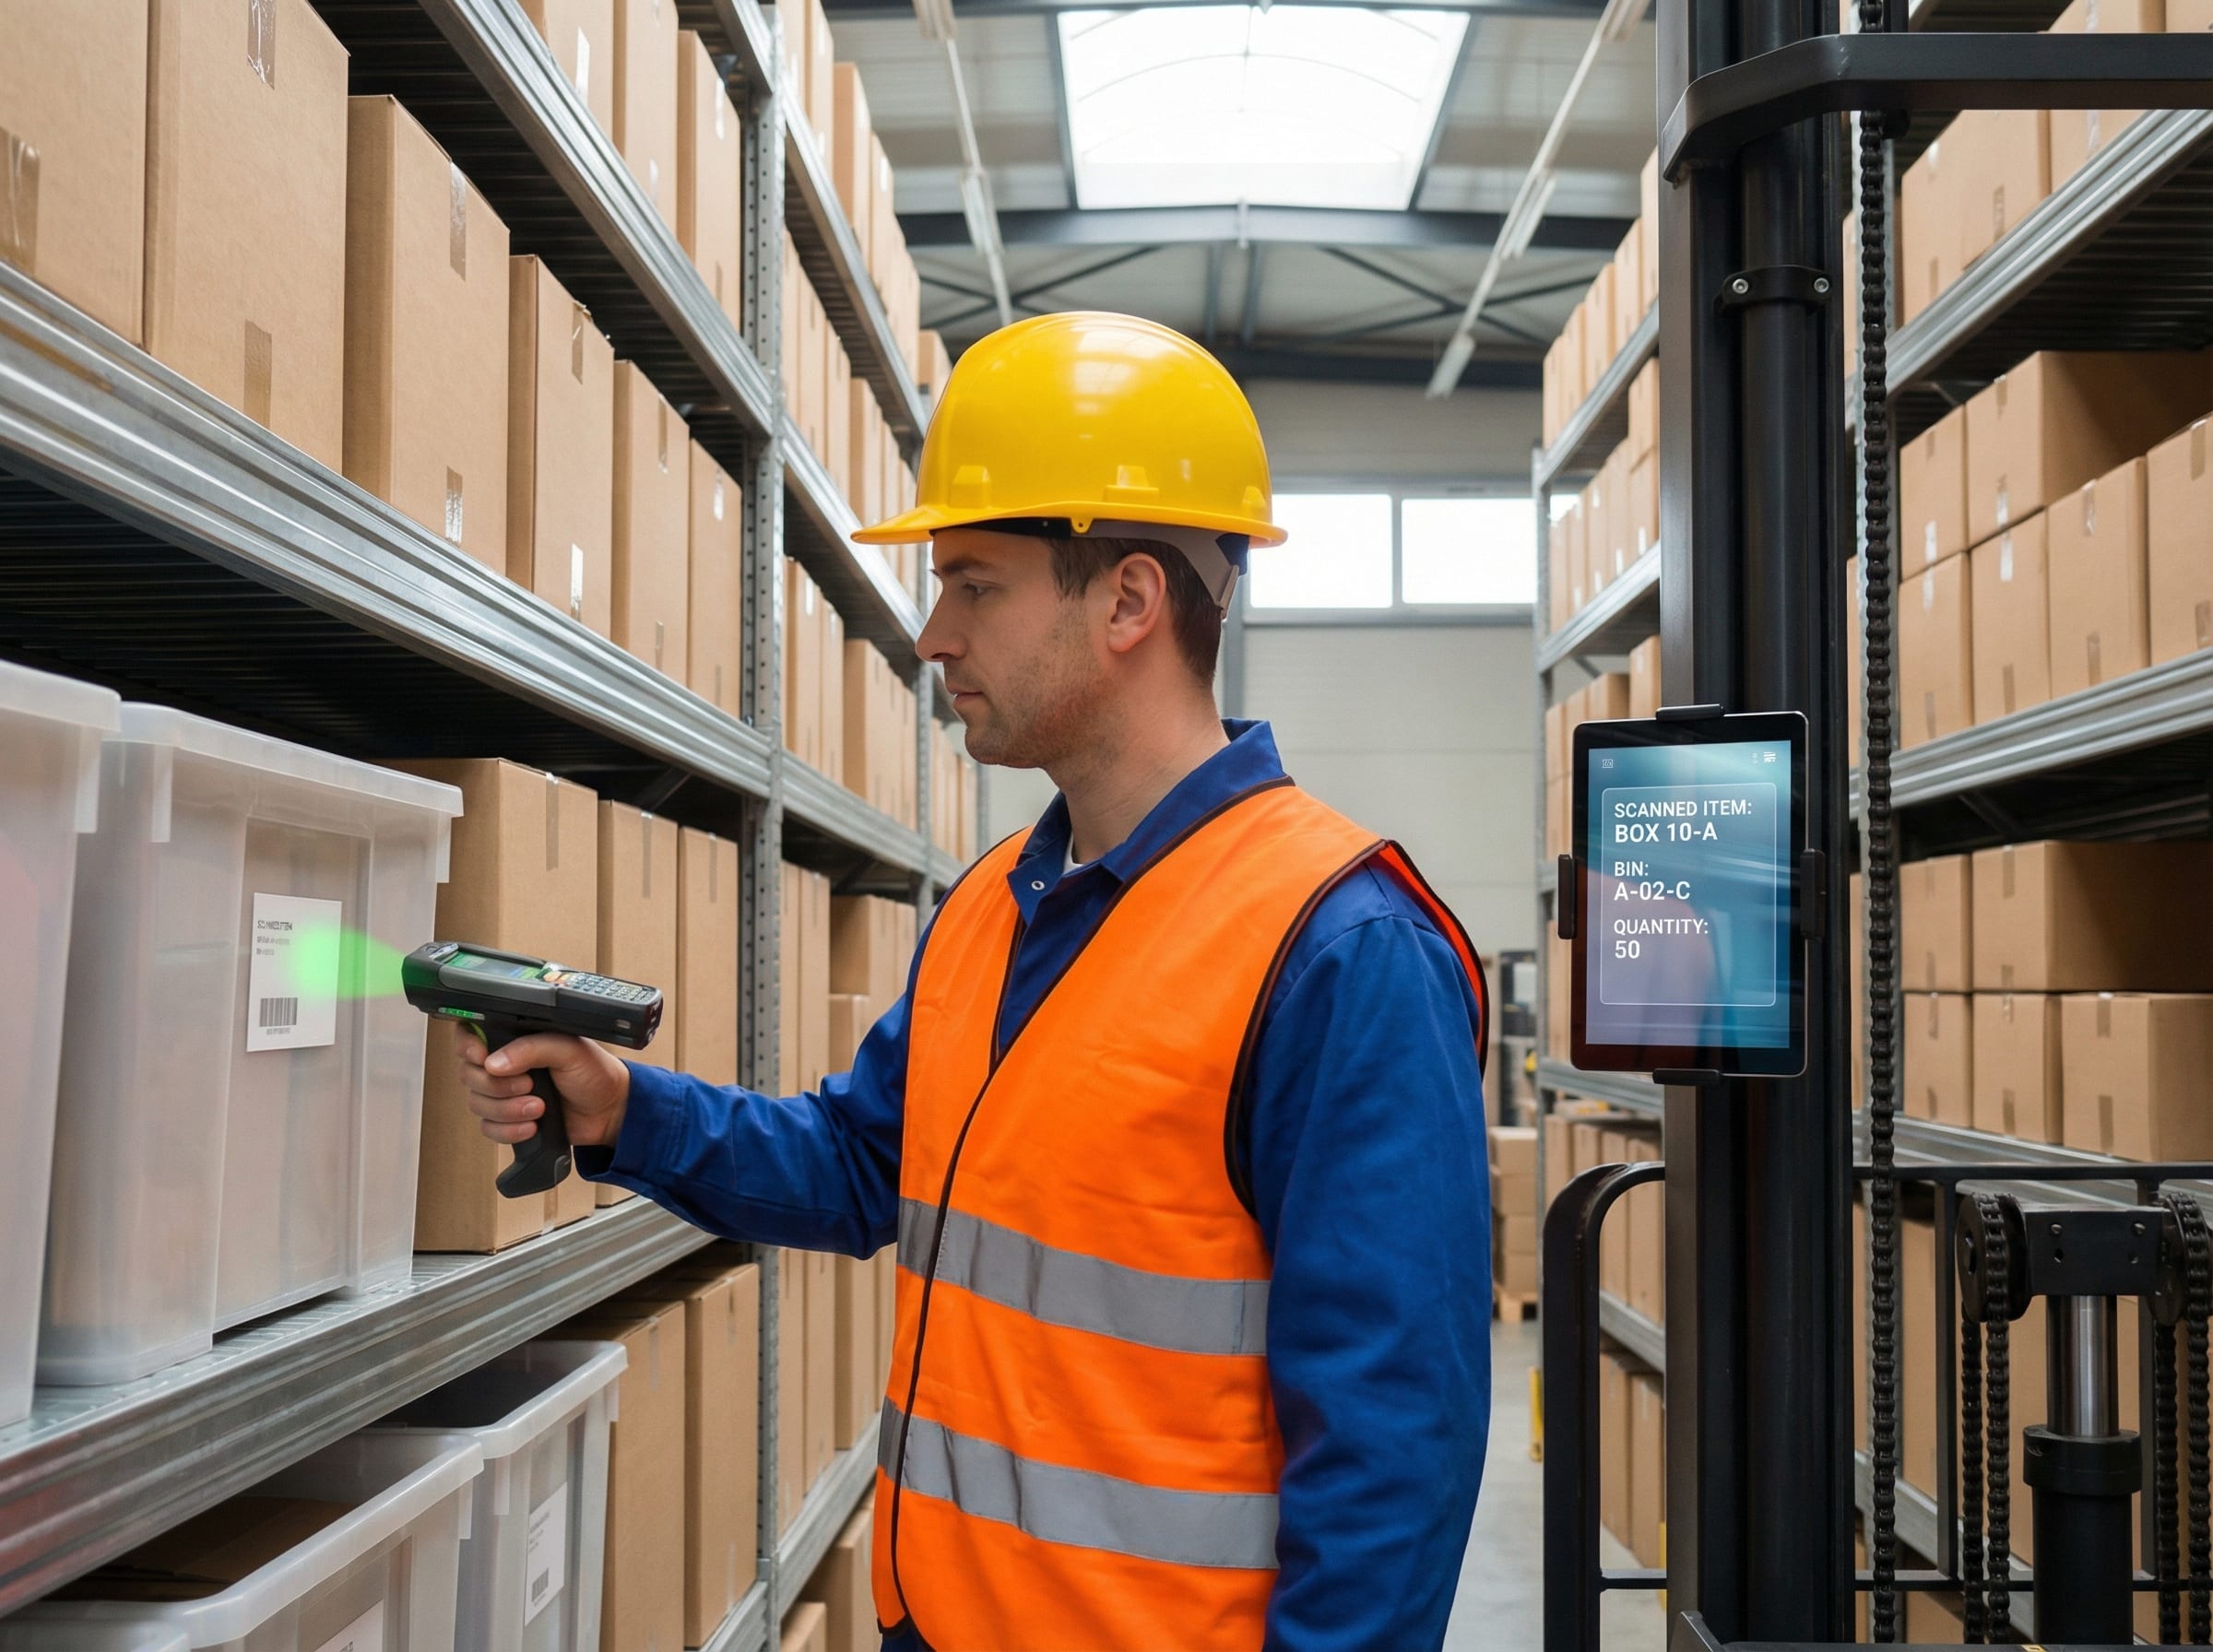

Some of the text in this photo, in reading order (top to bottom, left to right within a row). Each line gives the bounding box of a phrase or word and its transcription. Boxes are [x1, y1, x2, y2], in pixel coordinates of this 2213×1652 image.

[1614, 798, 1752, 818] SCANNED ITEM:
[1615, 821, 1719, 844] BOX 10-A
[1614, 860, 1649, 877] BIN:
[1614, 880, 1691, 901] A-02-C
[1613, 918, 1709, 937] QUANTITY:
[1615, 939, 1640, 960] 50
